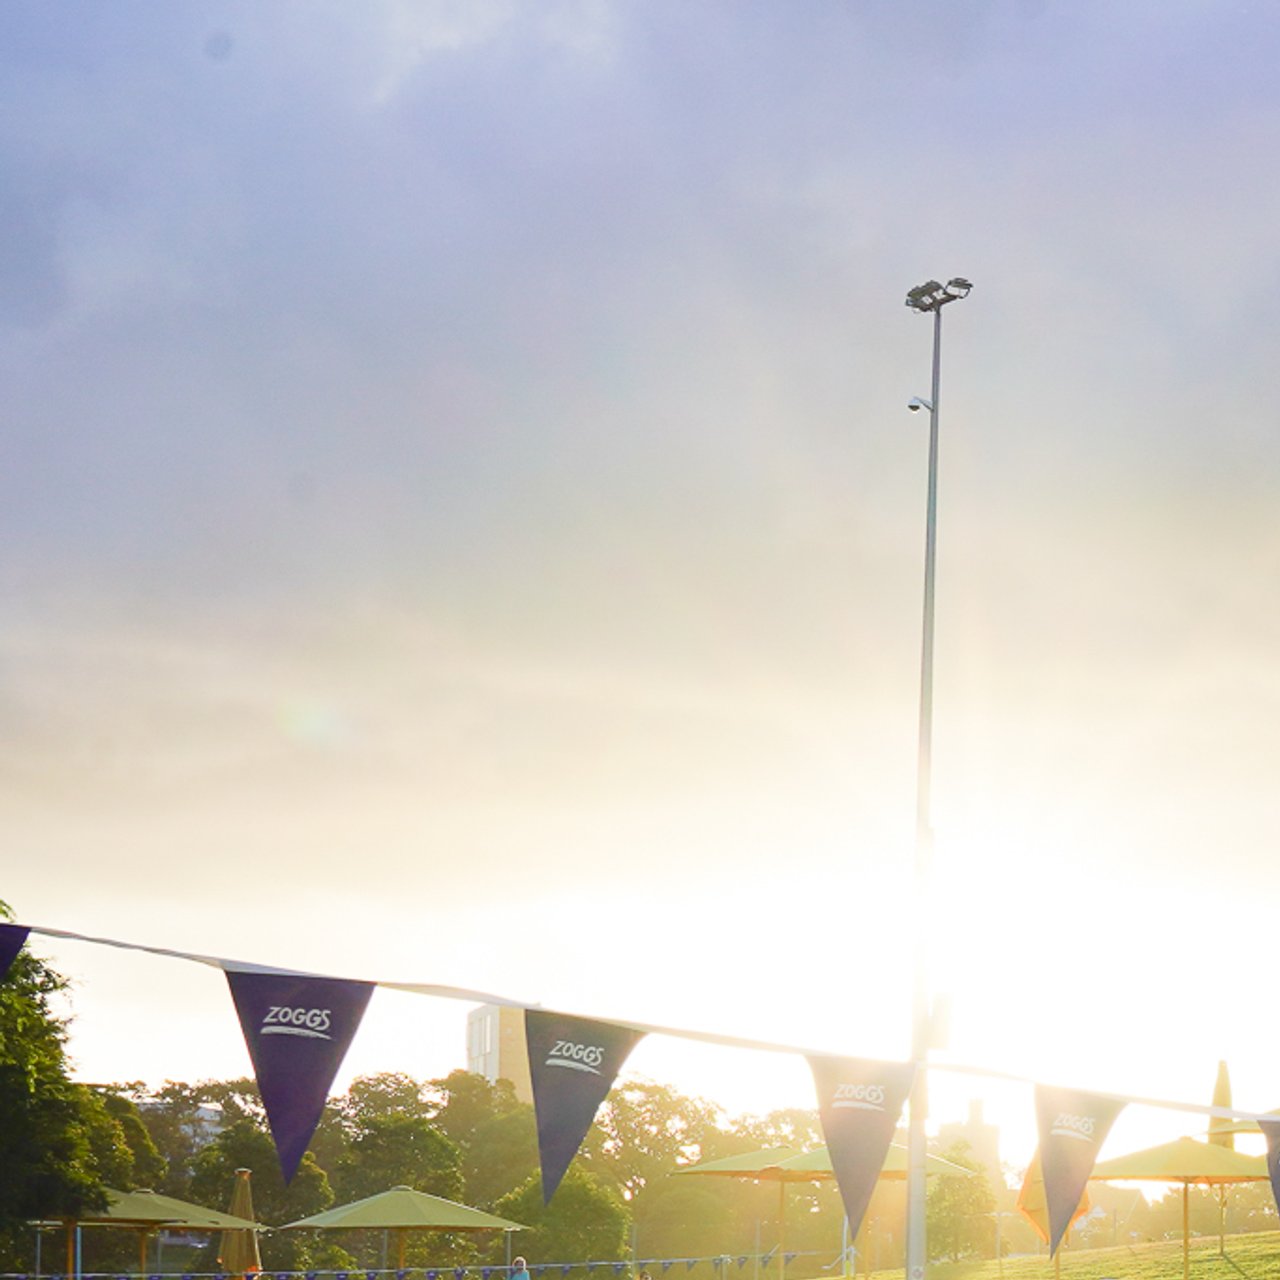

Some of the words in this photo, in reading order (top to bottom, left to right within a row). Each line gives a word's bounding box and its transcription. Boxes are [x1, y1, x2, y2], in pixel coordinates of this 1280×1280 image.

[262, 1006, 331, 1031] ZOGGS
[549, 1040, 605, 1067] ZOGGS
[833, 1083, 885, 1104] ZOGGS
